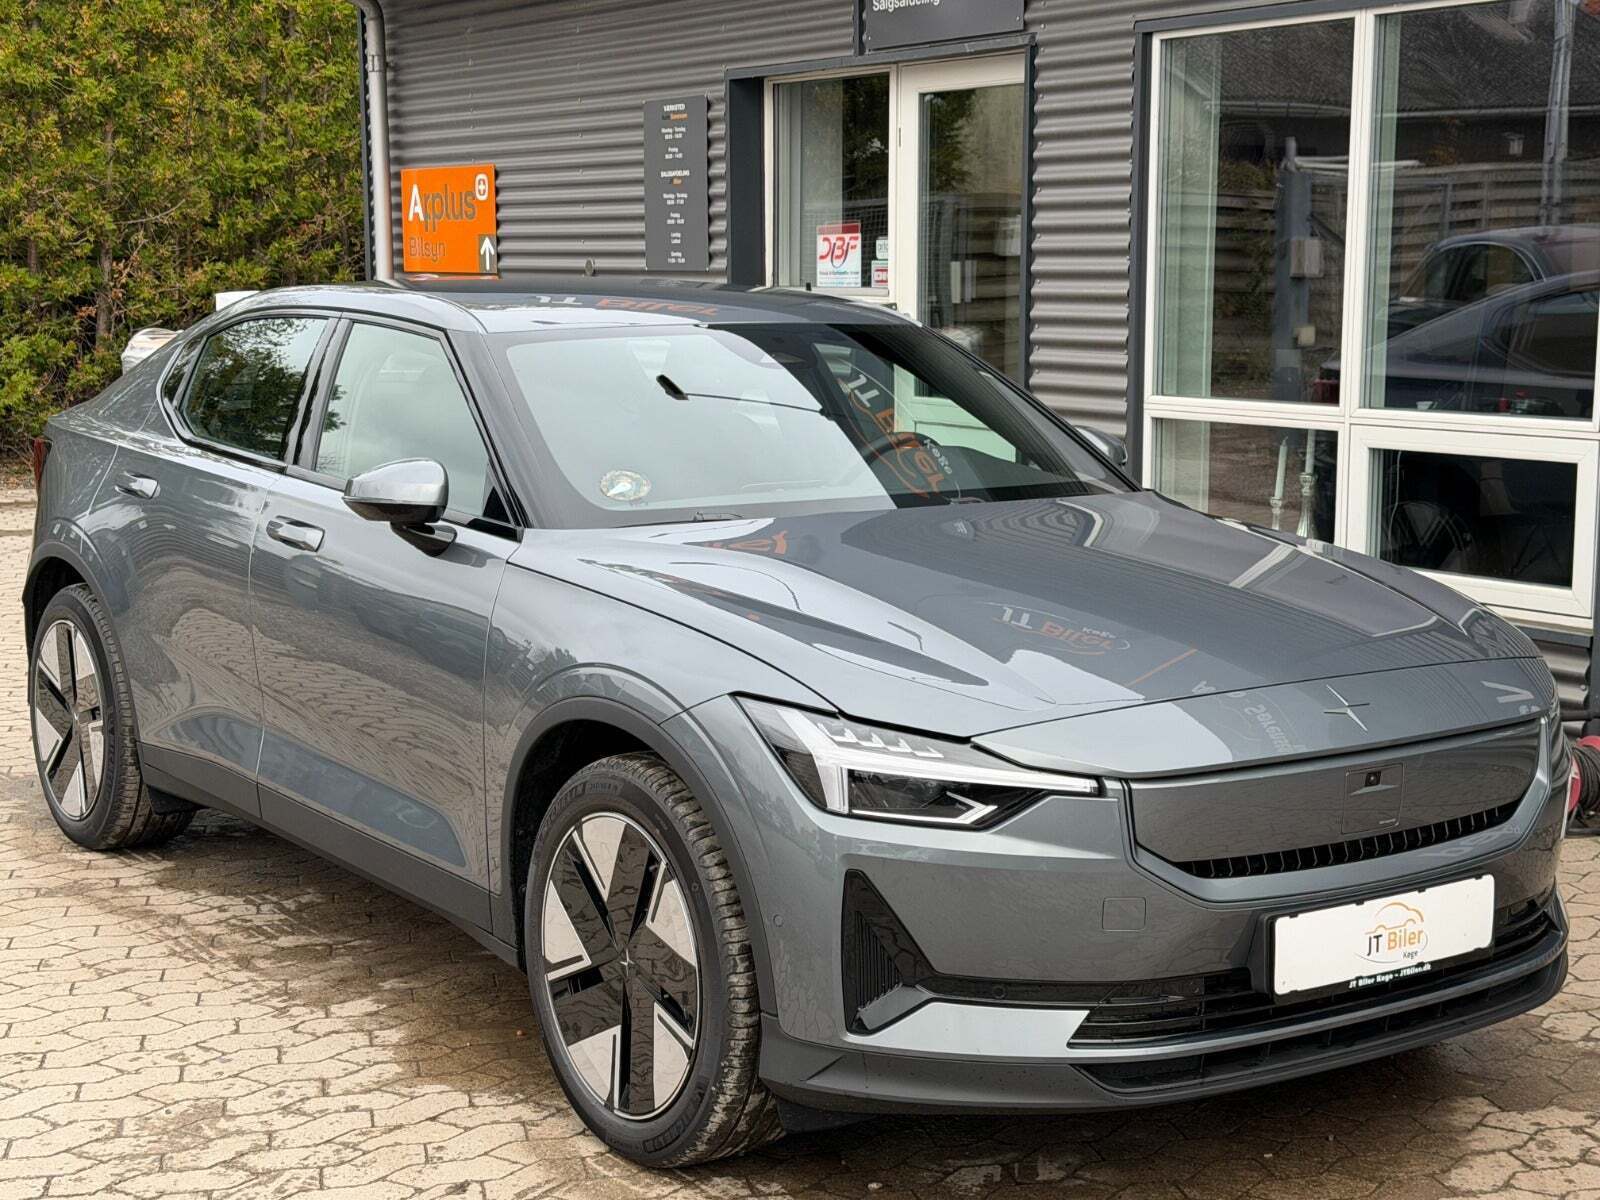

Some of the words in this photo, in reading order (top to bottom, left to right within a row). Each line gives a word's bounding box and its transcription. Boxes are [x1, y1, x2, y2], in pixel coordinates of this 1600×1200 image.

[409, 236, 446, 263] Bilsyn
[1366, 934, 1383, 956] JT
[1387, 928, 1424, 950] Biler
[1348, 980, 1357, 989] JT
[1358, 978, 1375, 988] Biler
